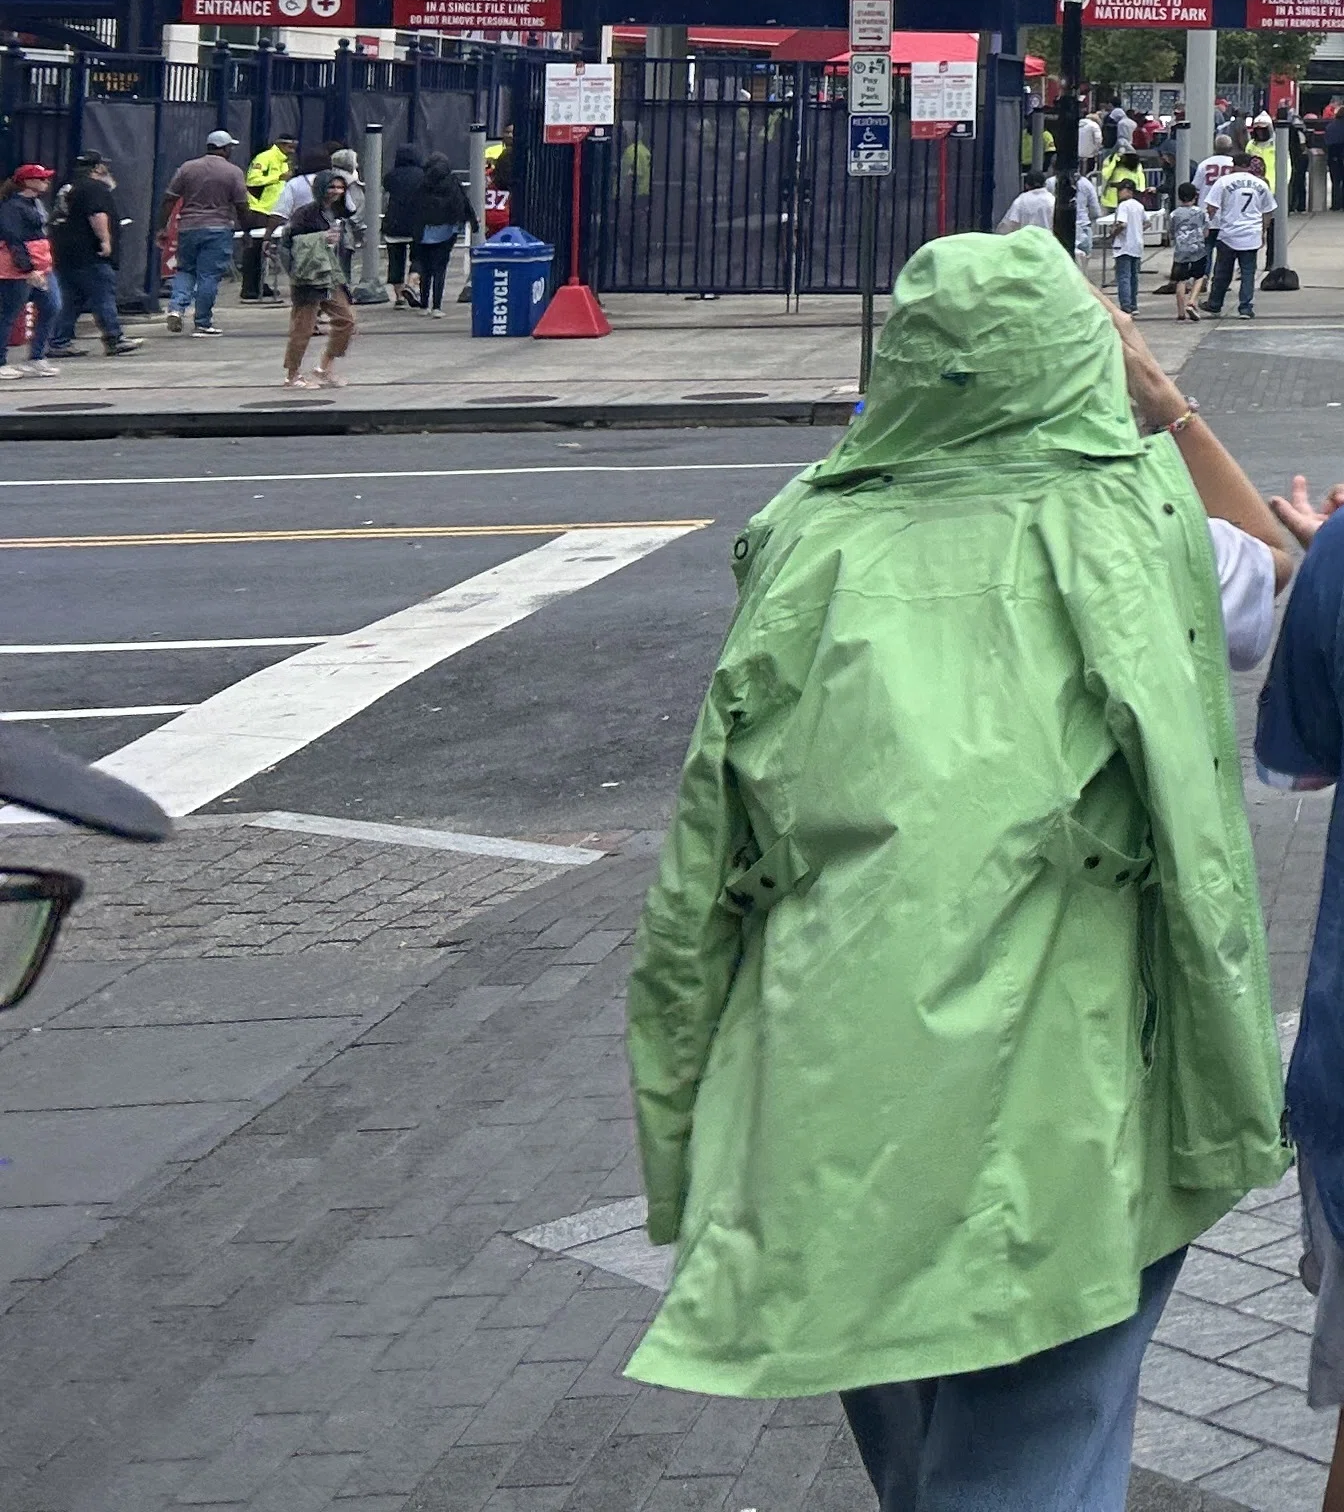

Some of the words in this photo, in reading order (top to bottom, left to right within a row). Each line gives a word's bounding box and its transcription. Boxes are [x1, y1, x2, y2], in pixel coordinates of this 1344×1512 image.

[195, 0, 272, 16] ENTRANCE
[426, 2, 436, 13] IN
[438, 2, 446, 13] A
[448, 2, 483, 14] SINGLE
[485, 2, 506, 14] FILE
[508, 3, 530, 15] LINE
[1095, 6, 1168, 21] NATIONALS
[1171, 8, 1207, 22] PARK
[1276, 6, 1285, 16] IN
[1286, 6, 1294, 16] A
[1296, 6, 1328, 16] SINGLE
[477, 16, 518, 27] PERSONAL
[1262, 18, 1272, 28] DO
[1274, 18, 1289, 28] NOT
[1291, 19, 1320, 28] REMOVE
[485, 190, 511, 210] 37
[1242, 192, 1253, 213] 7
[493, 268, 509, 337] RECYCLE
